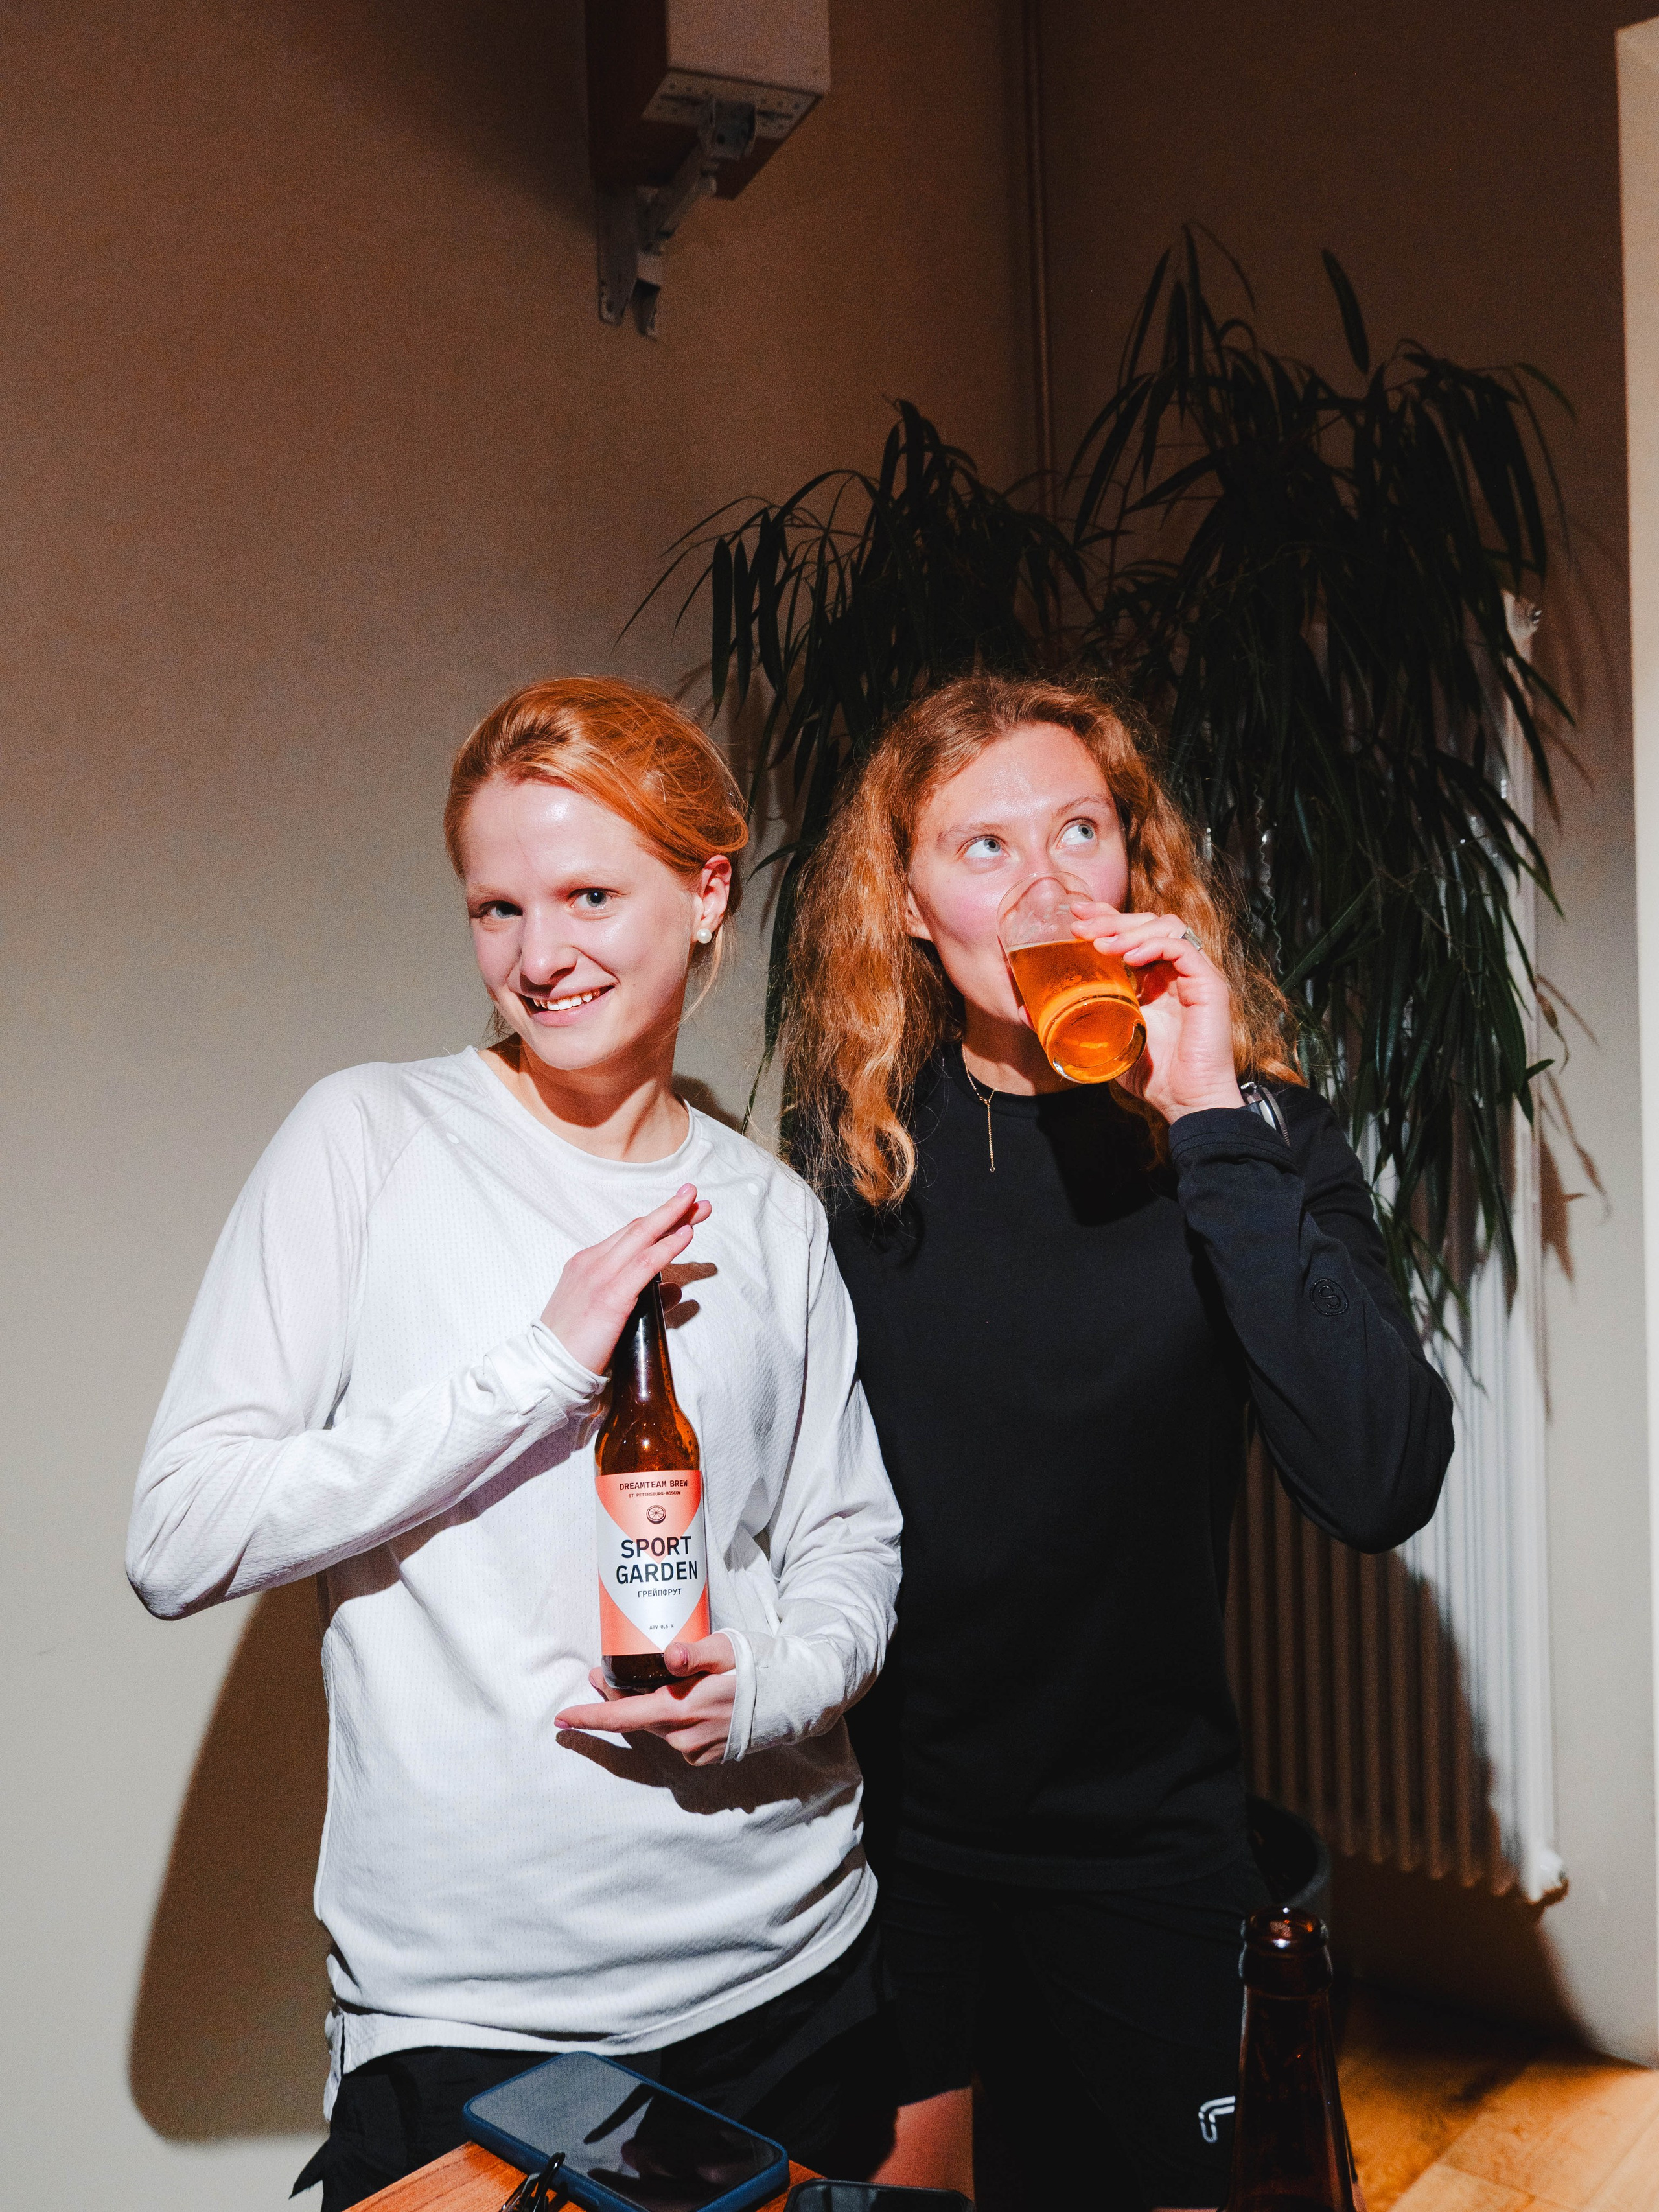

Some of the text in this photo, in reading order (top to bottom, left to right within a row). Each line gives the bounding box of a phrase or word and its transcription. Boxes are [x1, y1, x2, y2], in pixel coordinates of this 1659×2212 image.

[620, 1480, 667, 1491] DREAMTEAM
[621, 1535, 691, 1559] SPORT
[616, 1560, 698, 1585] GARDEN
[638, 1588, 682, 1598] ГРЕЙПФРУТ
